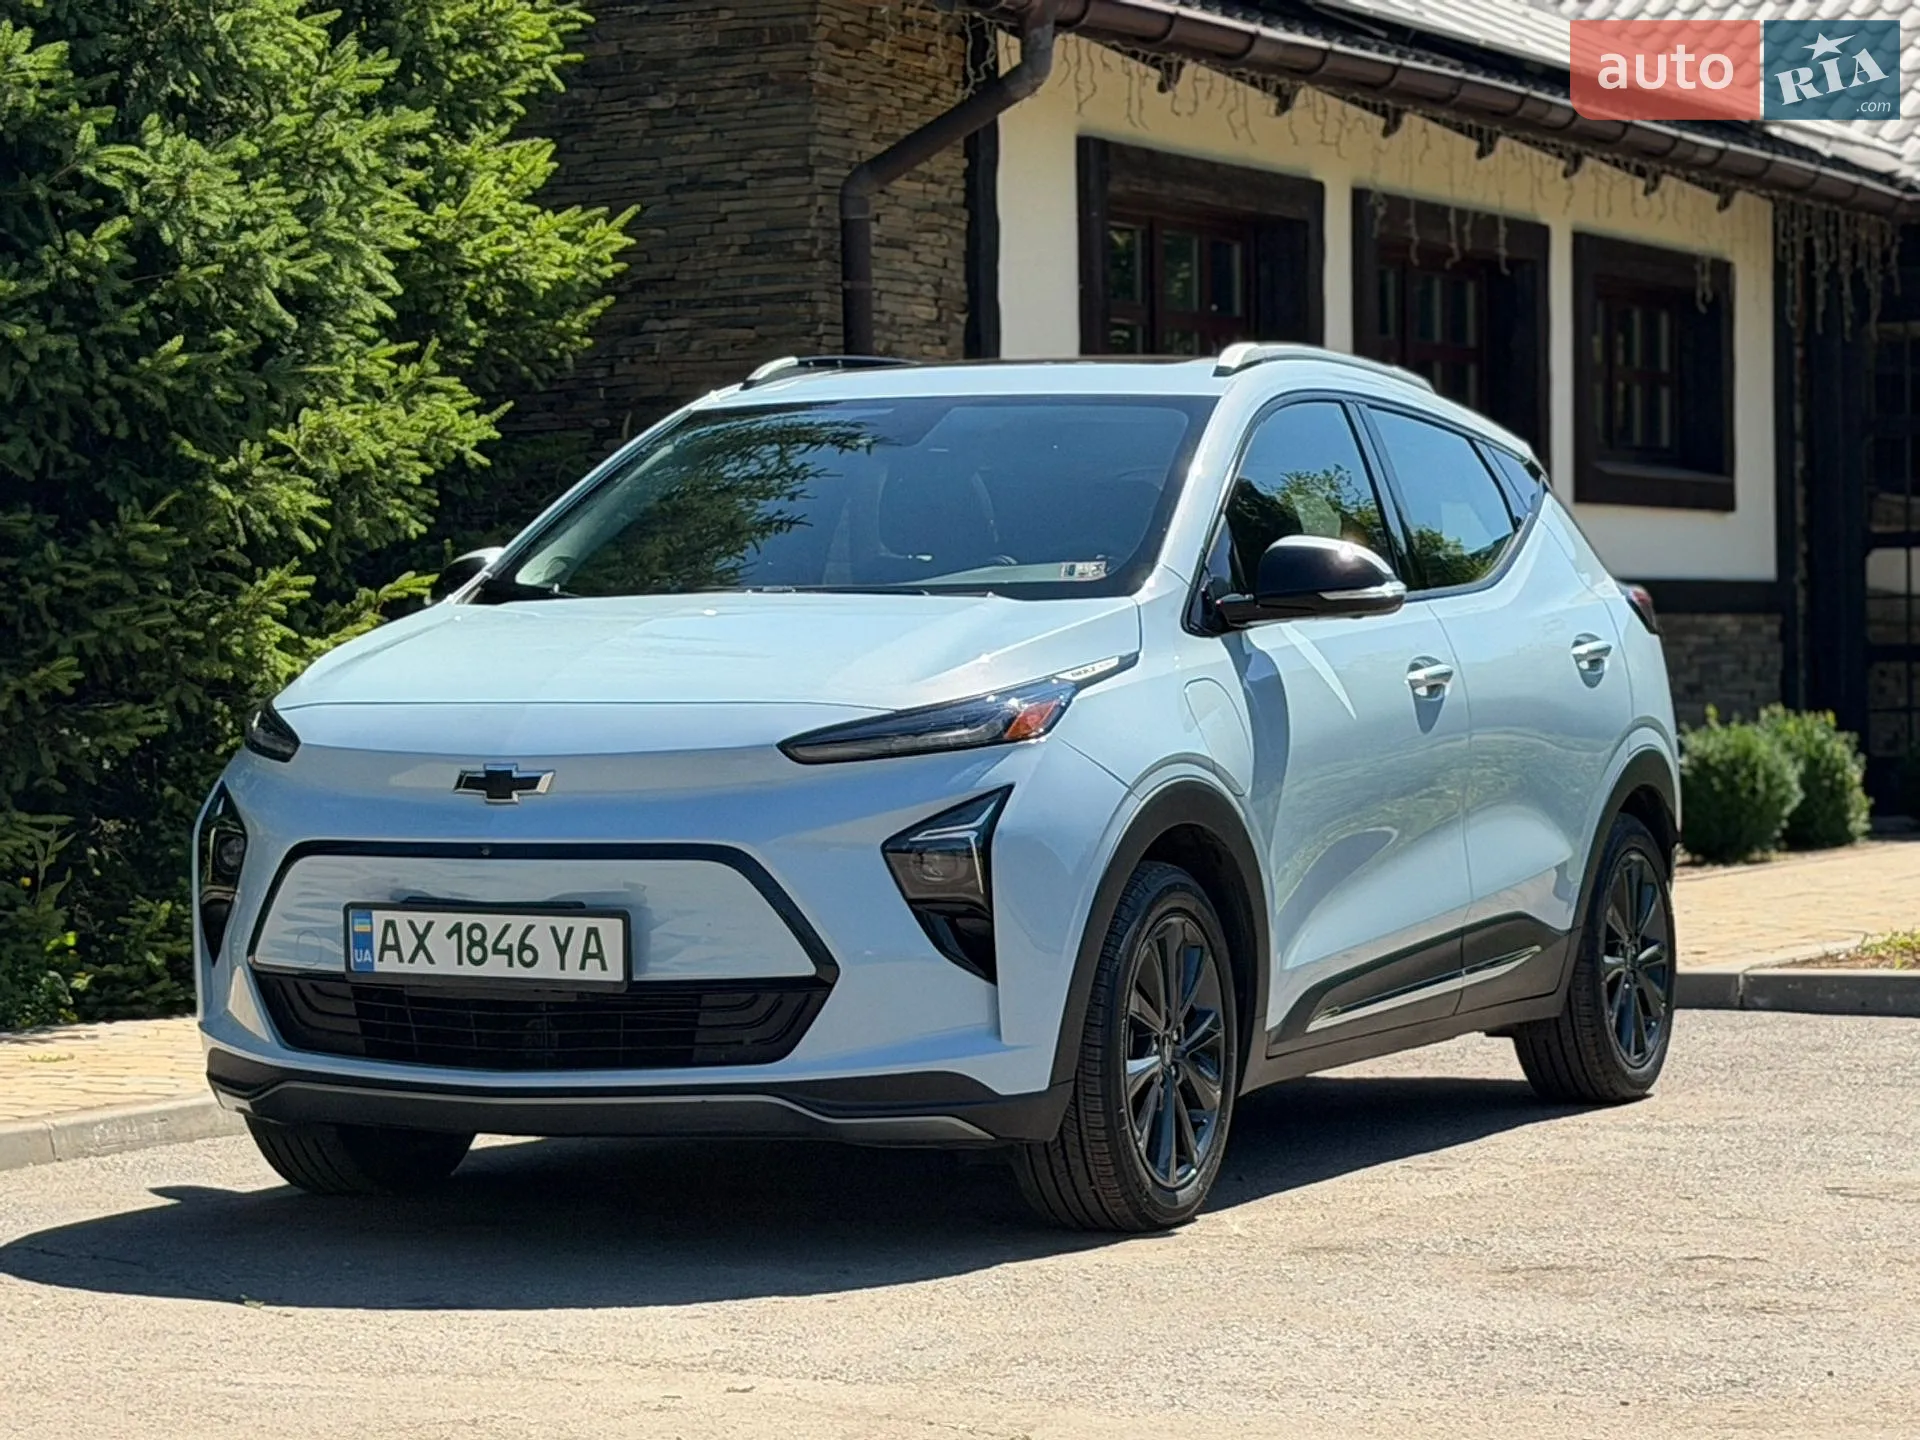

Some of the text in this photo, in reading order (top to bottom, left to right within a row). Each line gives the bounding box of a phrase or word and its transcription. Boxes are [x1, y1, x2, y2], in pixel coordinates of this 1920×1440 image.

[354, 950, 373, 963] UA
[378, 919, 608, 971] AX 1846 YA
